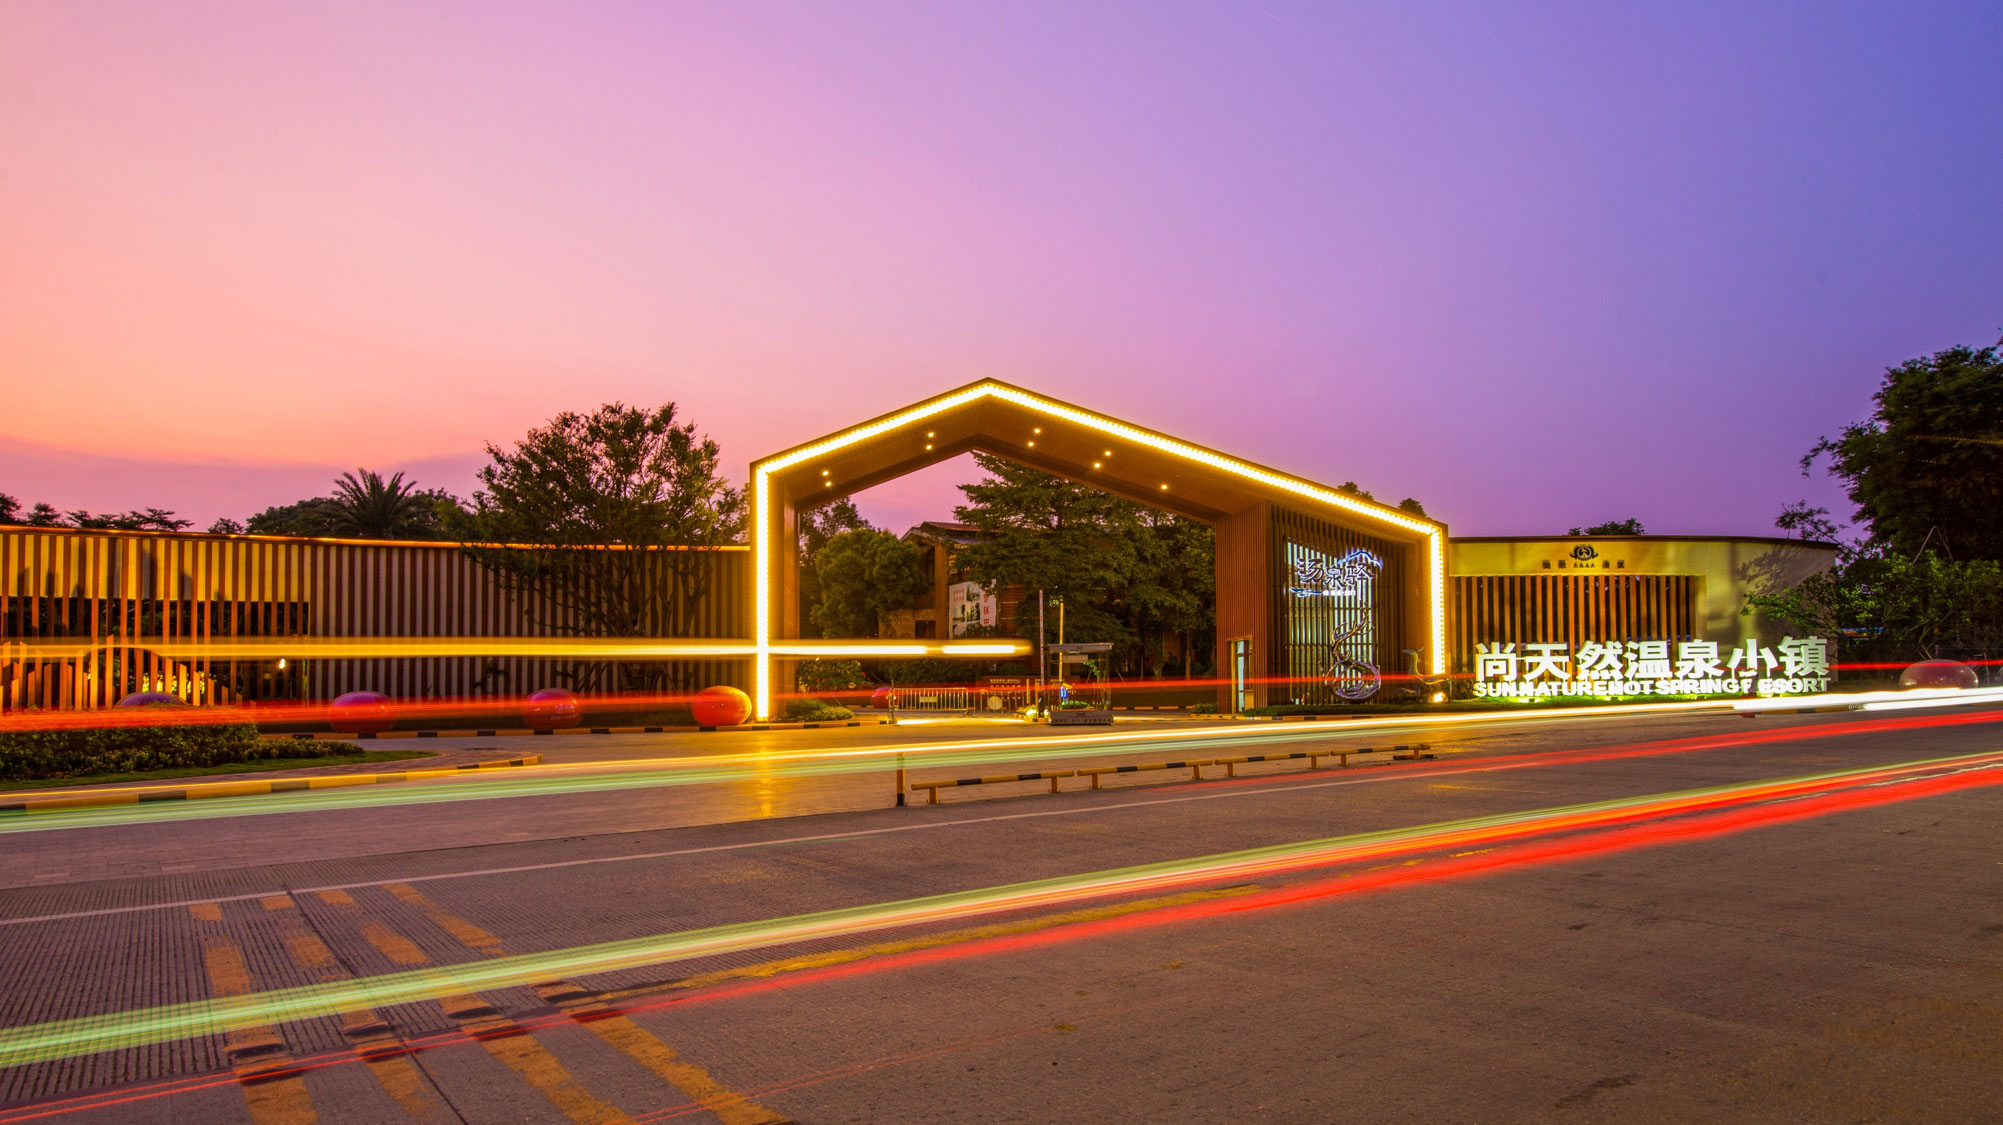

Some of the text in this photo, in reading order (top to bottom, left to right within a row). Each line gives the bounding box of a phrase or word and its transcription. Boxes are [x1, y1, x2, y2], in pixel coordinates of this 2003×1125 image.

[1297, 557, 1375, 601] 汤泉驿
[1474, 636, 1830, 680] 尚天然温泉小镇
[1655, 678, 1740, 695] SPRING
